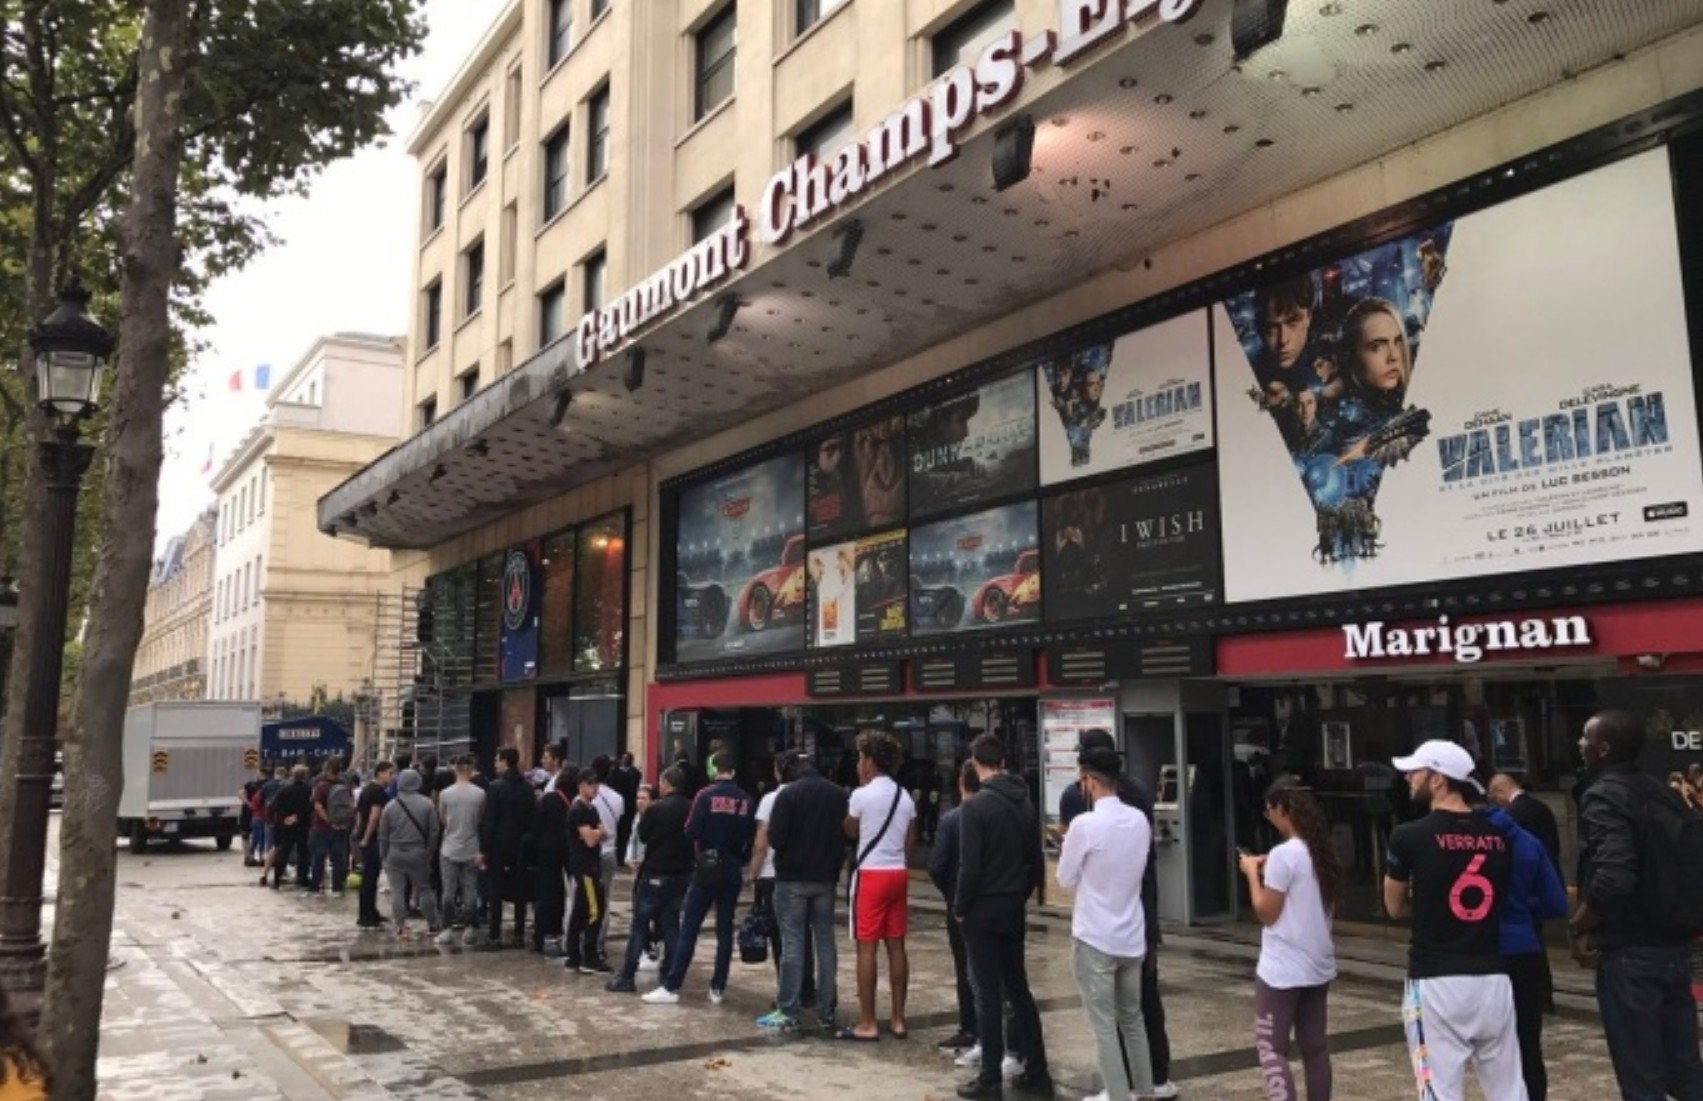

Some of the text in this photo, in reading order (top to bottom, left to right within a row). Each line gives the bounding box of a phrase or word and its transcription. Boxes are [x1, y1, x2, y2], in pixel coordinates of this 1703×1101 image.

[575, 0, 1203, 369] Gaumont Champs-E
[1437, 391, 1668, 482] VALERIAN
[1542, 475, 1568, 489] LUC
[1572, 465, 1631, 484] BESSON
[1120, 523, 1127, 543] I
[1135, 510, 1203, 540] WISH
[1487, 511, 1621, 542] LE 26 JUILLET
[1342, 615, 1591, 662] Marignan
[1448, 853, 1493, 921] 6
